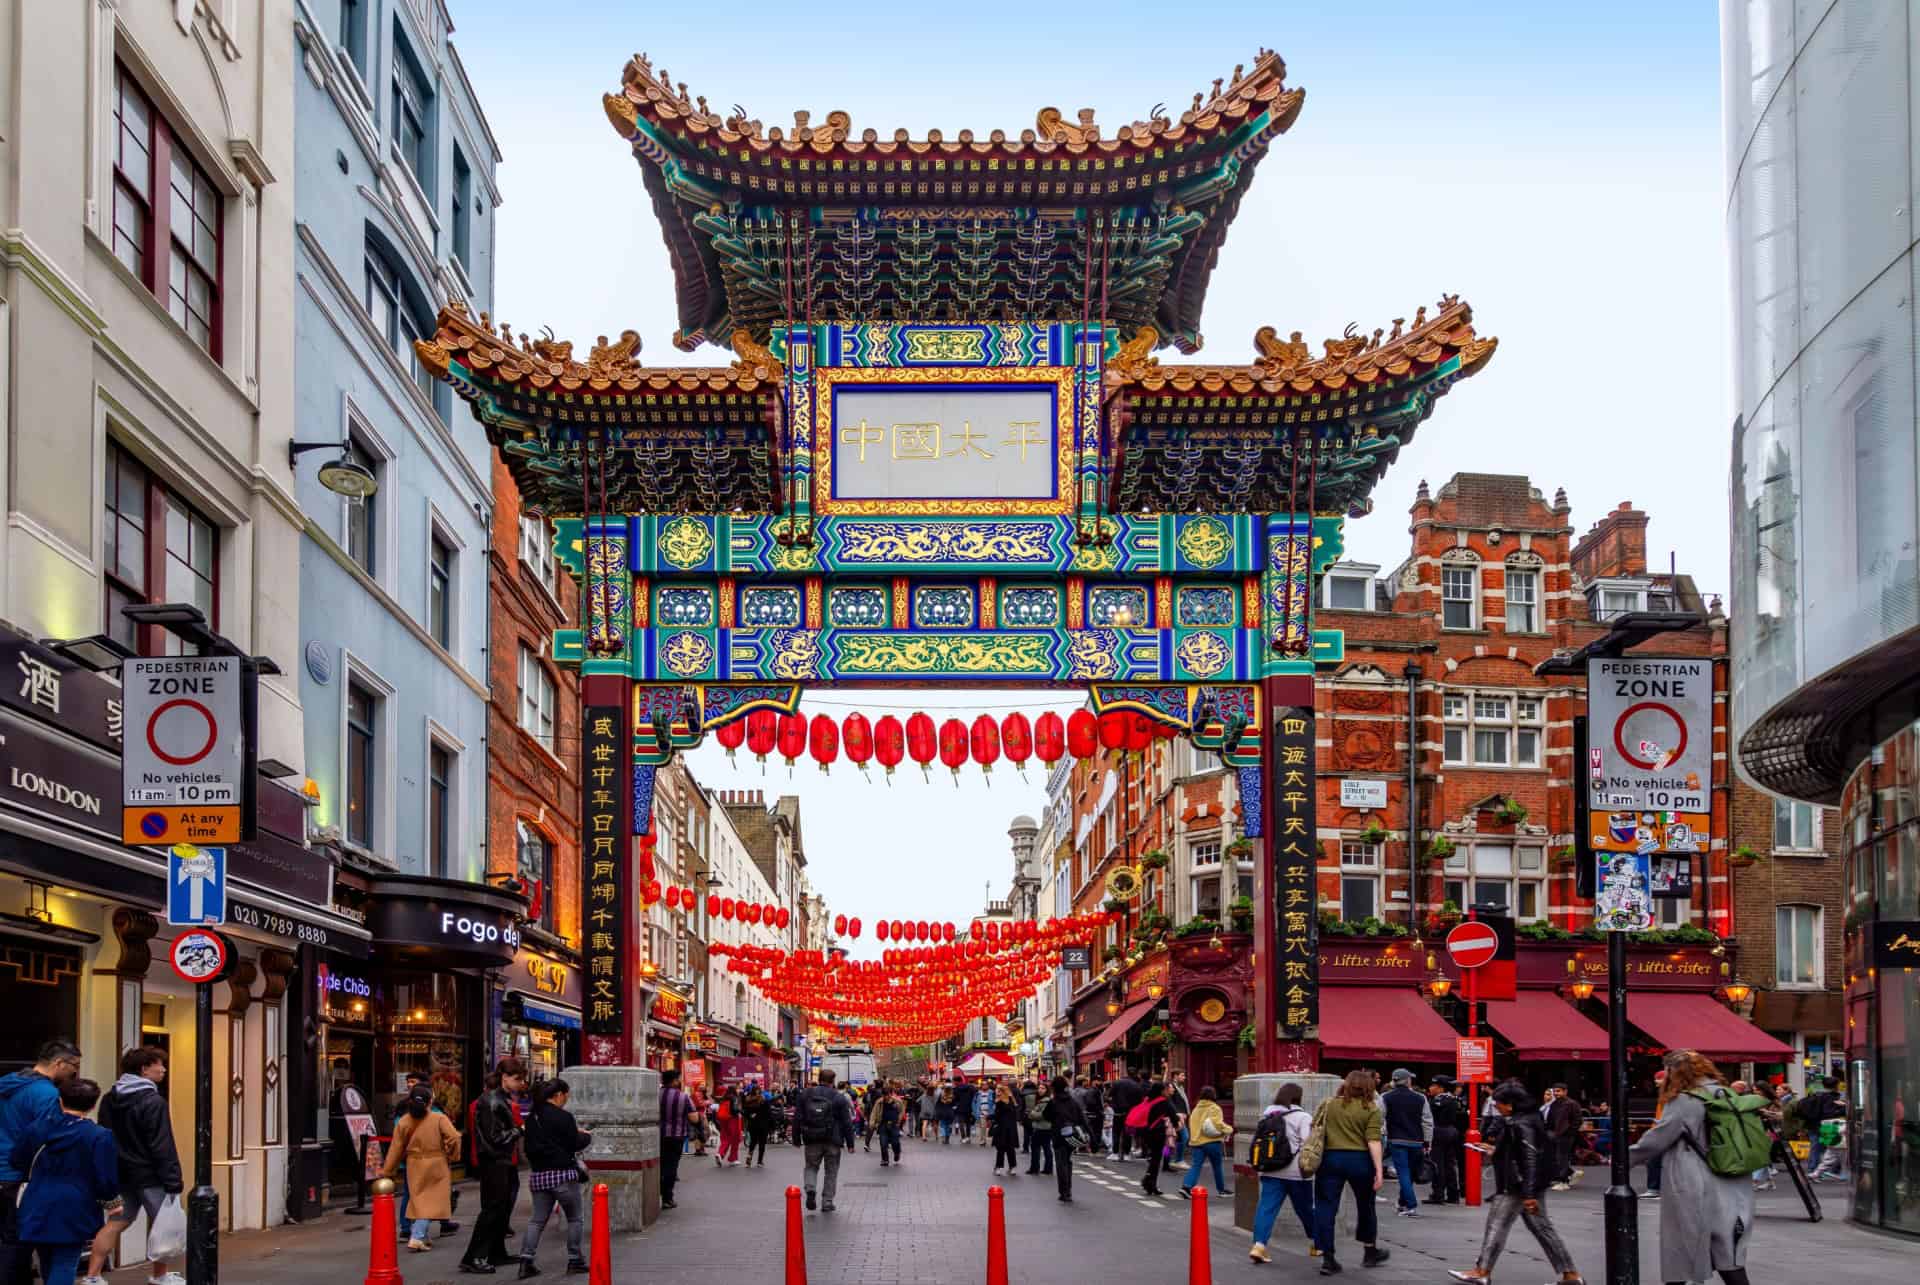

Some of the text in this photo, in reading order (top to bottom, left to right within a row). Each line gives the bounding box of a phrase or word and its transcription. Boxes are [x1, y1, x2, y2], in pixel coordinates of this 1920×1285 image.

[136, 662, 228, 673] PEDESTRIAN
[1602, 664, 1700, 676] PEDESTRIAN
[149, 678, 215, 694] ZONE
[1615, 680, 1686, 697] ZONE
[143, 773, 221, 783] No vehicles
[1610, 777, 1630, 788] No
[10, 767, 101, 815] LONDON
[130, 790, 140, 799] 11
[178, 787, 199, 799] 10
[204, 789, 230, 803] pm
[1597, 794, 1609, 803] 11
[1613, 795, 1632, 804] am
[1648, 793, 1668, 805] 10
[1674, 796, 1700, 808] pm
[180, 814, 223, 825] At any
[187, 826, 216, 837] time
[234, 905, 258, 926] 020
[263, 914, 293, 936] 7989
[298, 927, 327, 944] 8880
[442, 912, 498, 943] Fogo
[1069, 952, 1083, 961] 22
[528, 958, 545, 979] Old
